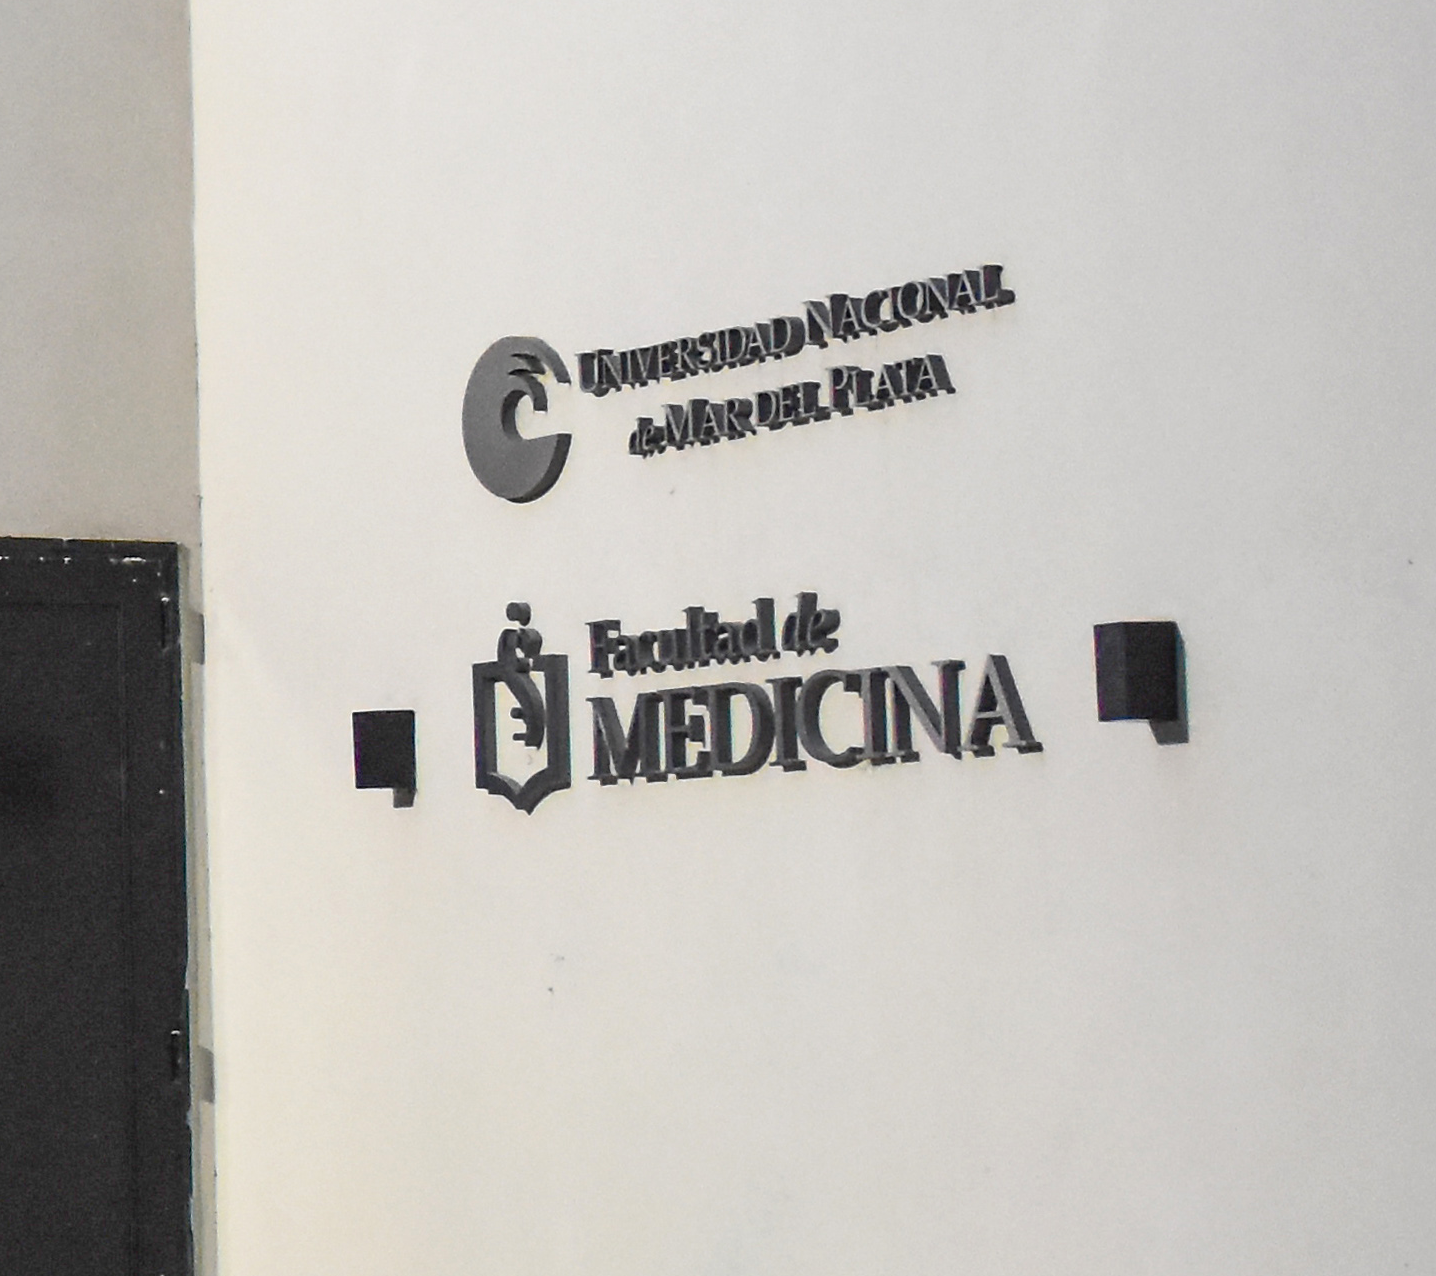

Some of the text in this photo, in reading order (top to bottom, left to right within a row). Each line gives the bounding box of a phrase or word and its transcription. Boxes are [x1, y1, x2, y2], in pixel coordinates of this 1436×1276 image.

[575, 264, 1016, 397] UNIVERSIDAD NACIONAL
[628, 353, 956, 459] de MAR DEL PLATA
[584, 591, 841, 680] Facultad de
[585, 653, 1045, 787] MEDICINA
